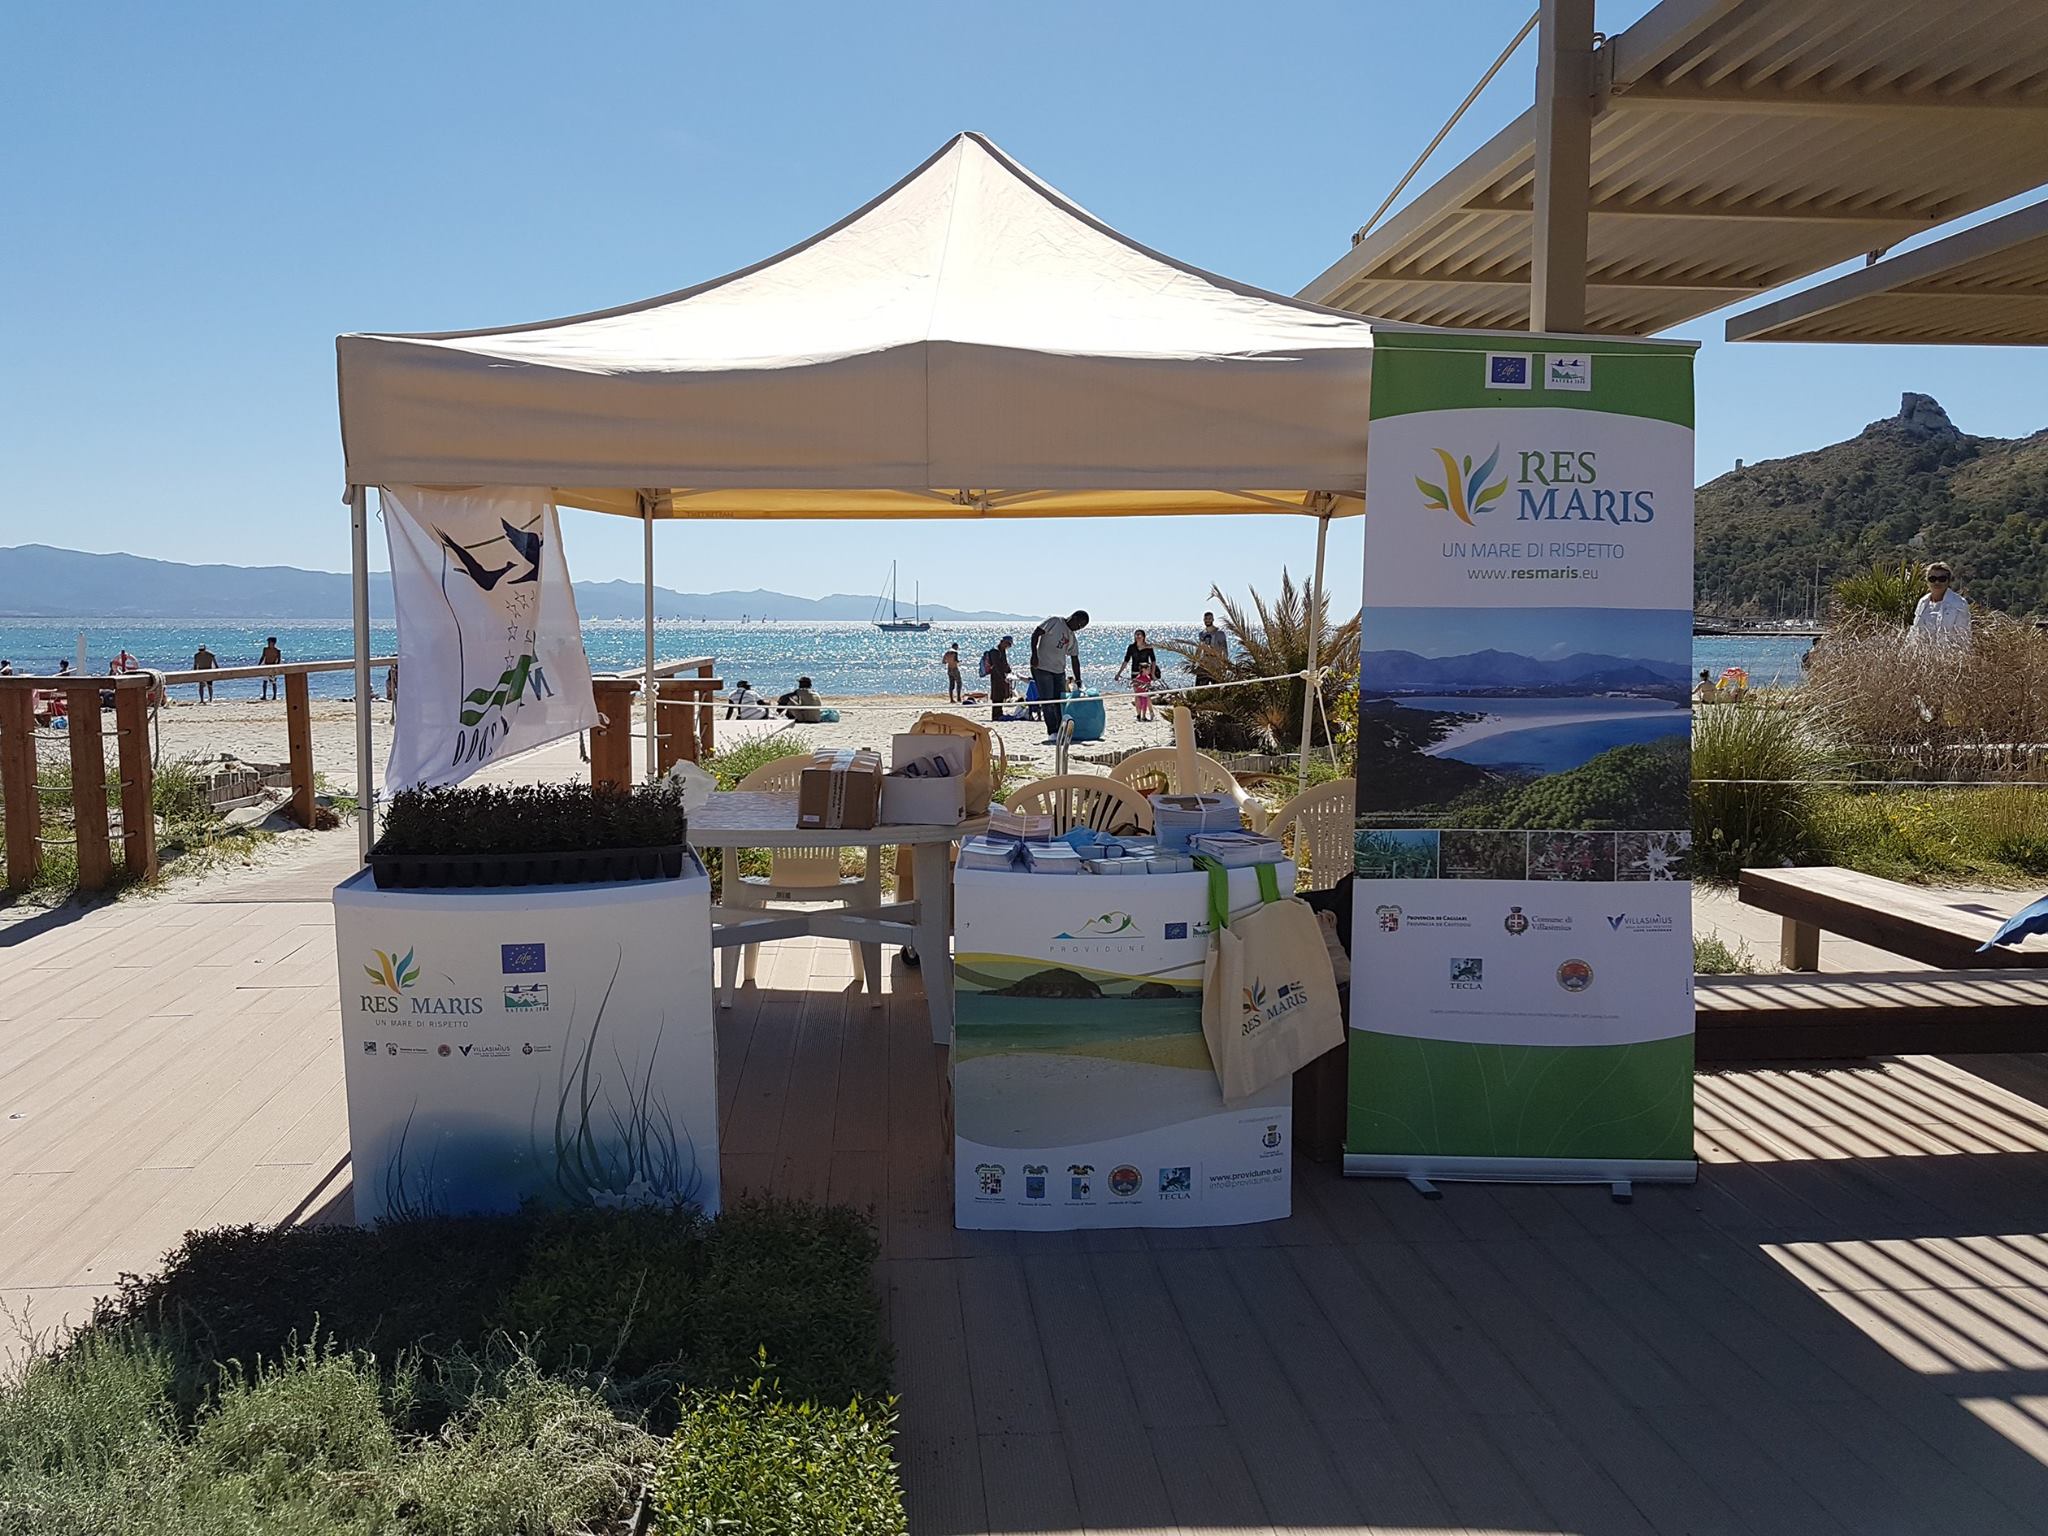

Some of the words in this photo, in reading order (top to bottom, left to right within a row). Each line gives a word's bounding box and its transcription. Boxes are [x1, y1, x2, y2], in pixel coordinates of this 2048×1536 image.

[1516, 450, 1597, 487] RES
[1516, 487, 1655, 526] MARIS
[1442, 542, 1466, 558] UN
[1471, 542, 1522, 559] MARE
[1527, 543, 1544, 559] DI
[1549, 542, 1625, 560] RISPETTO
[1467, 565, 1599, 581] www.resmaris.eu
[1531, 915, 1563, 923] Comune
[1050, 944, 1145, 953] PROVIDUNE
[1450, 982, 1483, 990] TECLA
[360, 994, 399, 1014] RES
[411, 996, 484, 1016] MARIS
[1241, 1014, 1262, 1037] RES
[1265, 990, 1309, 1021] MARIS
[375, 1018, 387, 1027] UN
[390, 1019, 412, 1028] MARE
[416, 1020, 425, 1028] DI
[429, 1021, 469, 1029] RISPETTO
[1208, 1167, 1283, 1182] www.providune.eu
